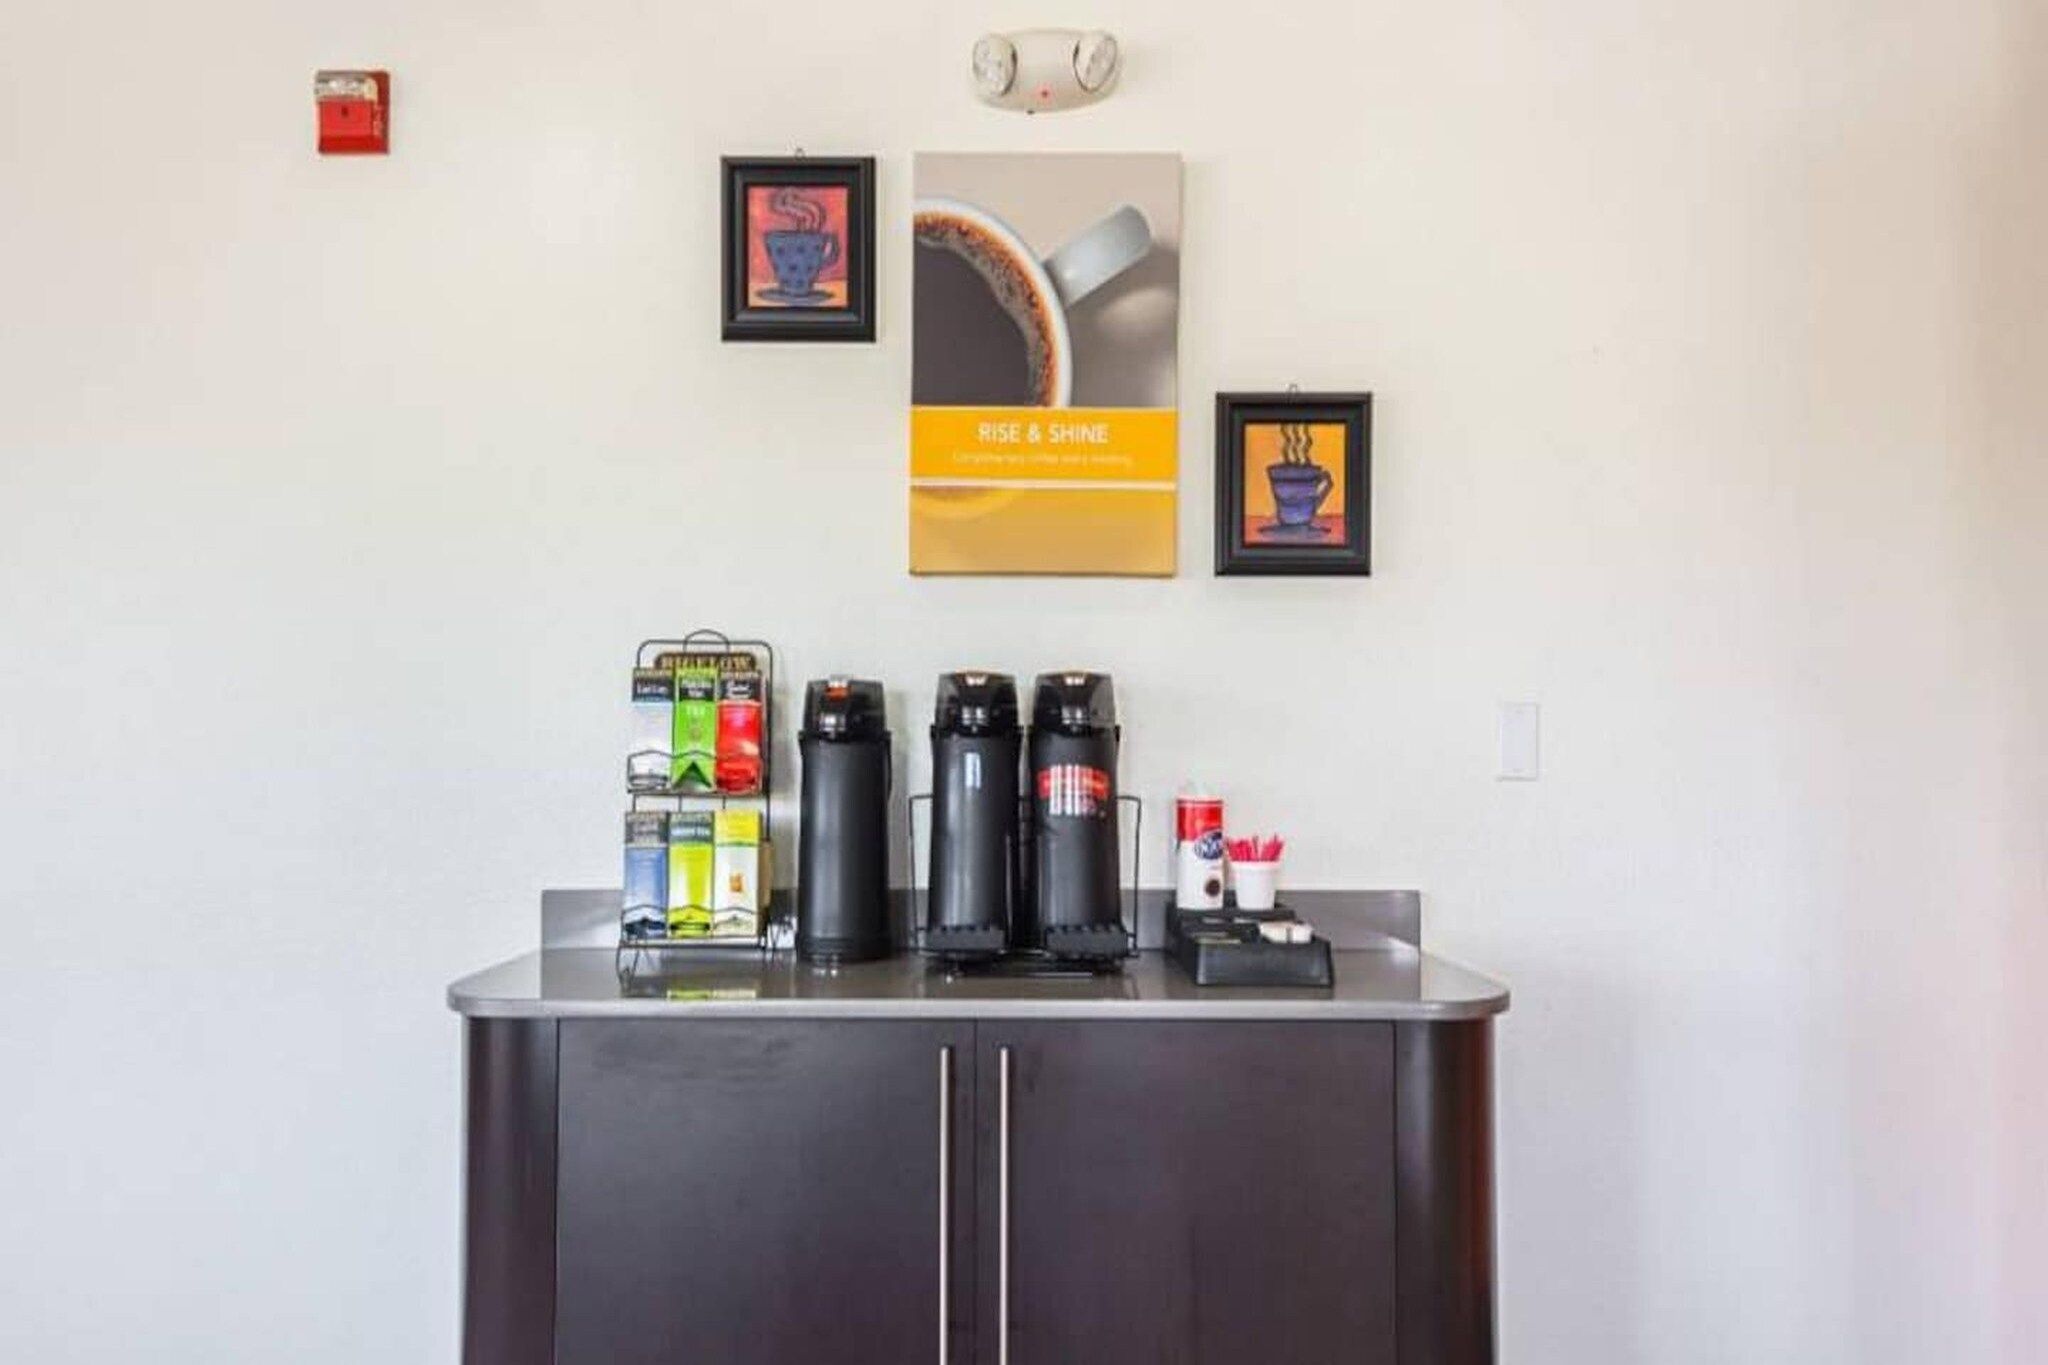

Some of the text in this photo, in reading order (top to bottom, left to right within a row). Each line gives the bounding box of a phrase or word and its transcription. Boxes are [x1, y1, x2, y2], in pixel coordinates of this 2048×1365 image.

[978, 422, 1106, 443] RISE & SHINE
